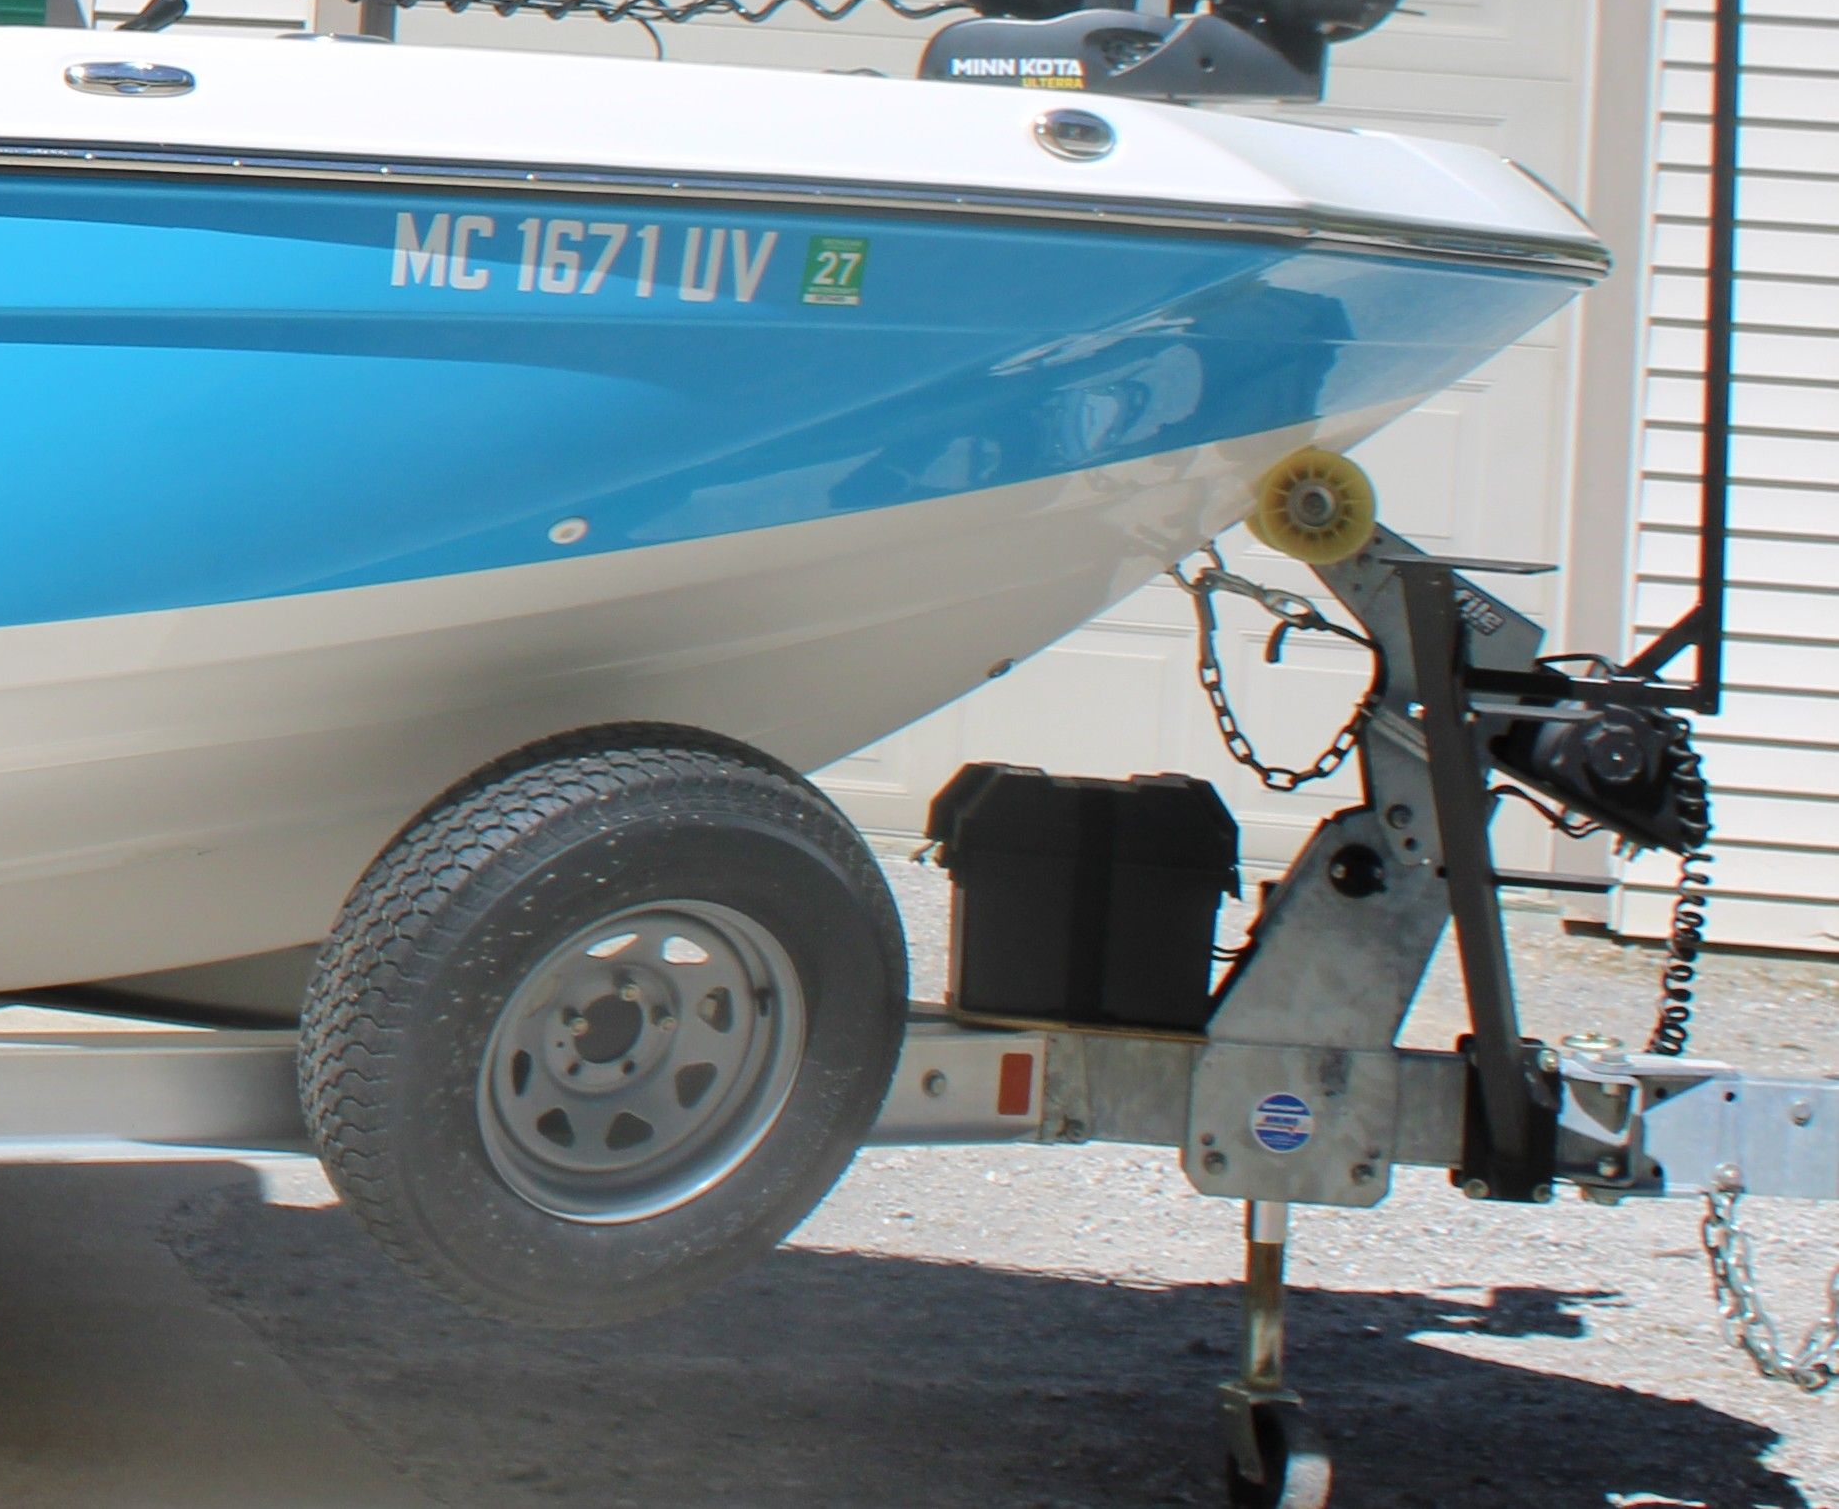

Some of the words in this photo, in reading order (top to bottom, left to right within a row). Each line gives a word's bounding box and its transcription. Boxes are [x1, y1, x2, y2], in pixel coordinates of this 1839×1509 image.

[950, 57, 1016, 77] MINN
[1018, 57, 1084, 77] KOTA
[1021, 76, 1086, 90] ULTERRA
[390, 211, 495, 291] MC
[516, 216, 661, 299] 1671
[678, 226, 779, 303] UV
[812, 250, 863, 286] 27
